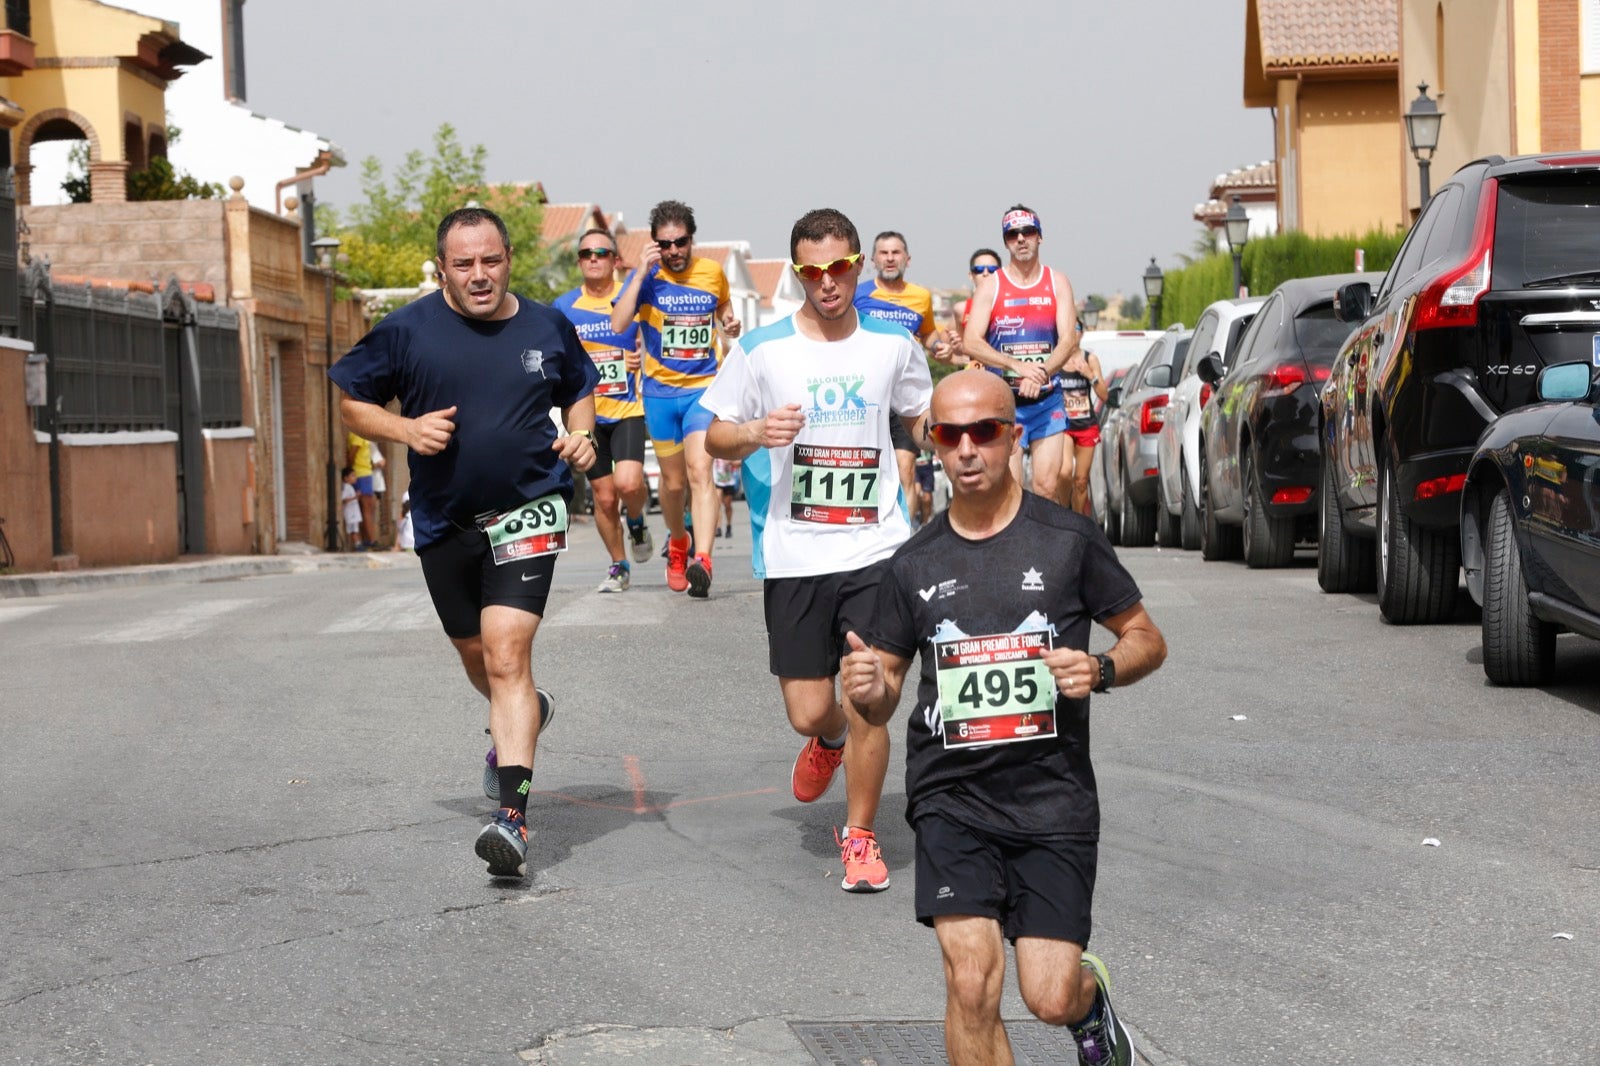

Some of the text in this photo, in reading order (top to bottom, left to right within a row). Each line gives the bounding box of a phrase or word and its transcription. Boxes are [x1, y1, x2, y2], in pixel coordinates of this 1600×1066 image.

[658, 293, 712, 308] agustinos
[1028, 296, 1052, 305] SEUR
[869, 309, 918, 321] agustinos
[574, 319, 612, 336] agusti
[667, 327, 709, 345] 1190
[808, 381, 866, 411] 10K
[814, 448, 830, 458] GRAN
[830, 449, 852, 459] PREMIO
[853, 450, 860, 459] DE
[861, 450, 876, 459] FONDO
[799, 470, 876, 500] 1117
[960, 642, 980, 654] GRAN
[982, 638, 1009, 652] PREMIO
[1010, 637, 1020, 649] DE
[994, 650, 1028, 661] CRUZCAMPO
[958, 666, 1038, 708] 495
